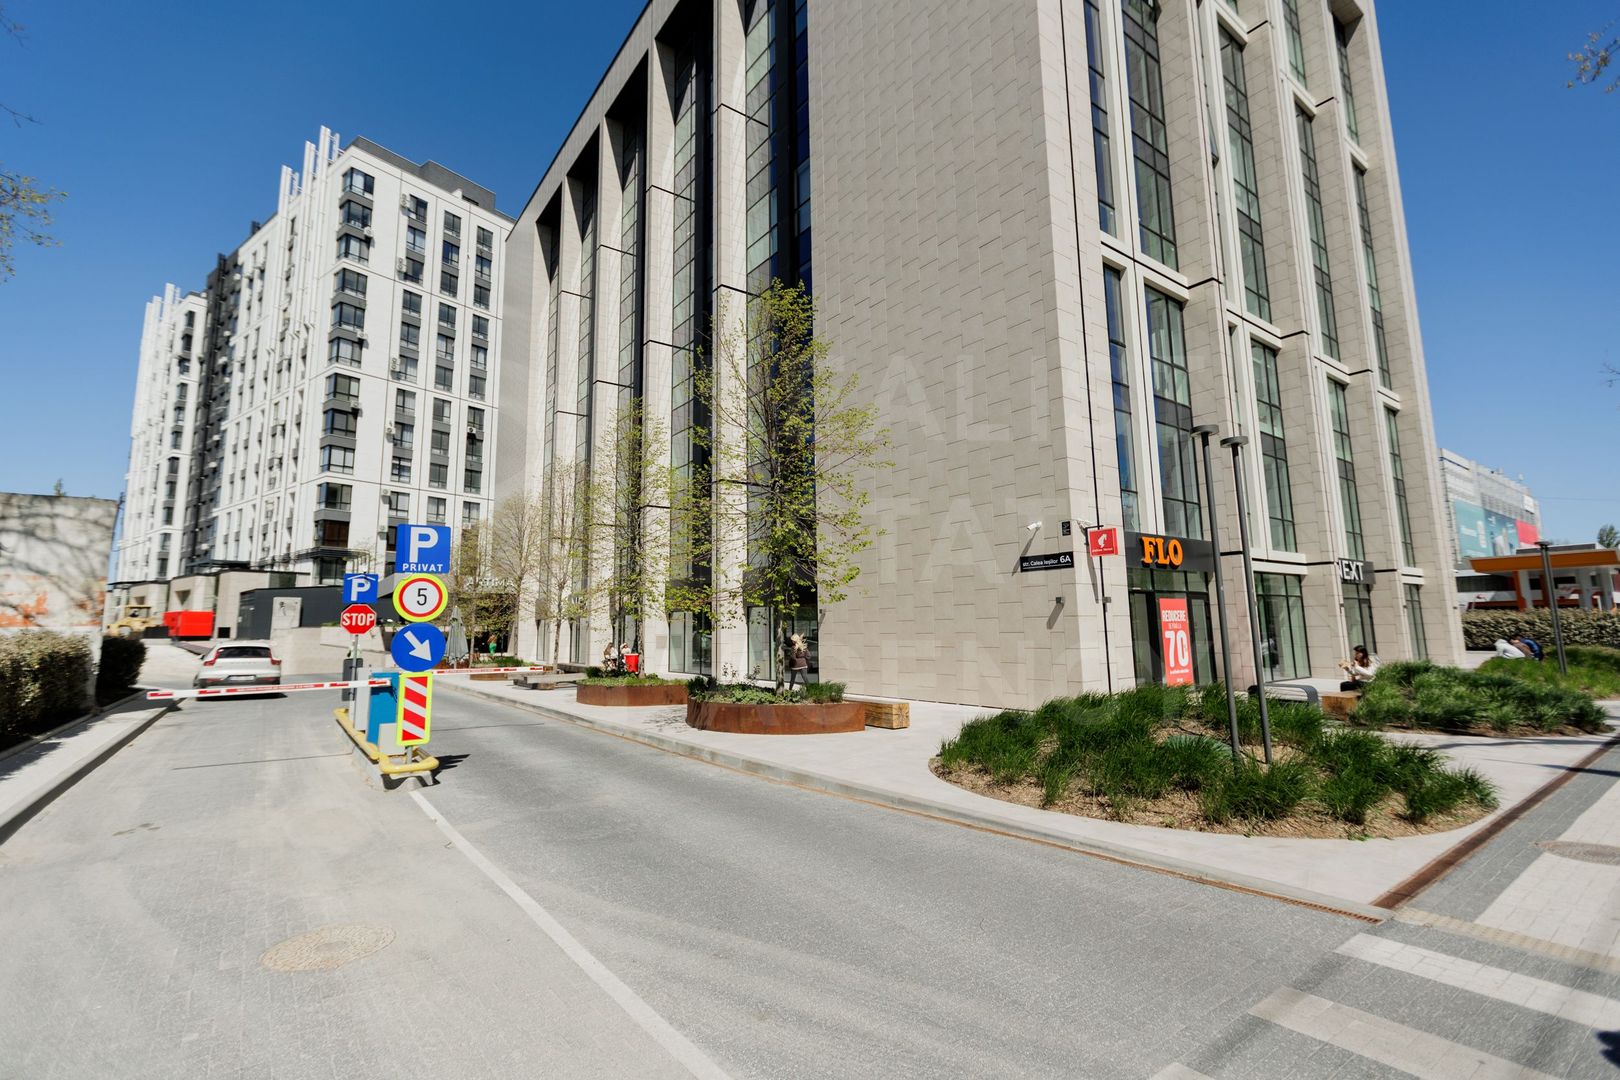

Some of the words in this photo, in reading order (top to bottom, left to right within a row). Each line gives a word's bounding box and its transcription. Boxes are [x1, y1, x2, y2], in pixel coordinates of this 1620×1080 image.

[409, 526, 439, 563] P
[1140, 536, 1184, 566] FLO
[402, 563, 444, 572] PRIVAT
[1059, 555, 1071, 563] 6A
[1339, 560, 1363, 580] NEXT
[350, 579, 371, 602] P
[416, 588, 428, 606] 5
[342, 612, 375, 626] STOP
[1164, 630, 1189, 668] 70
